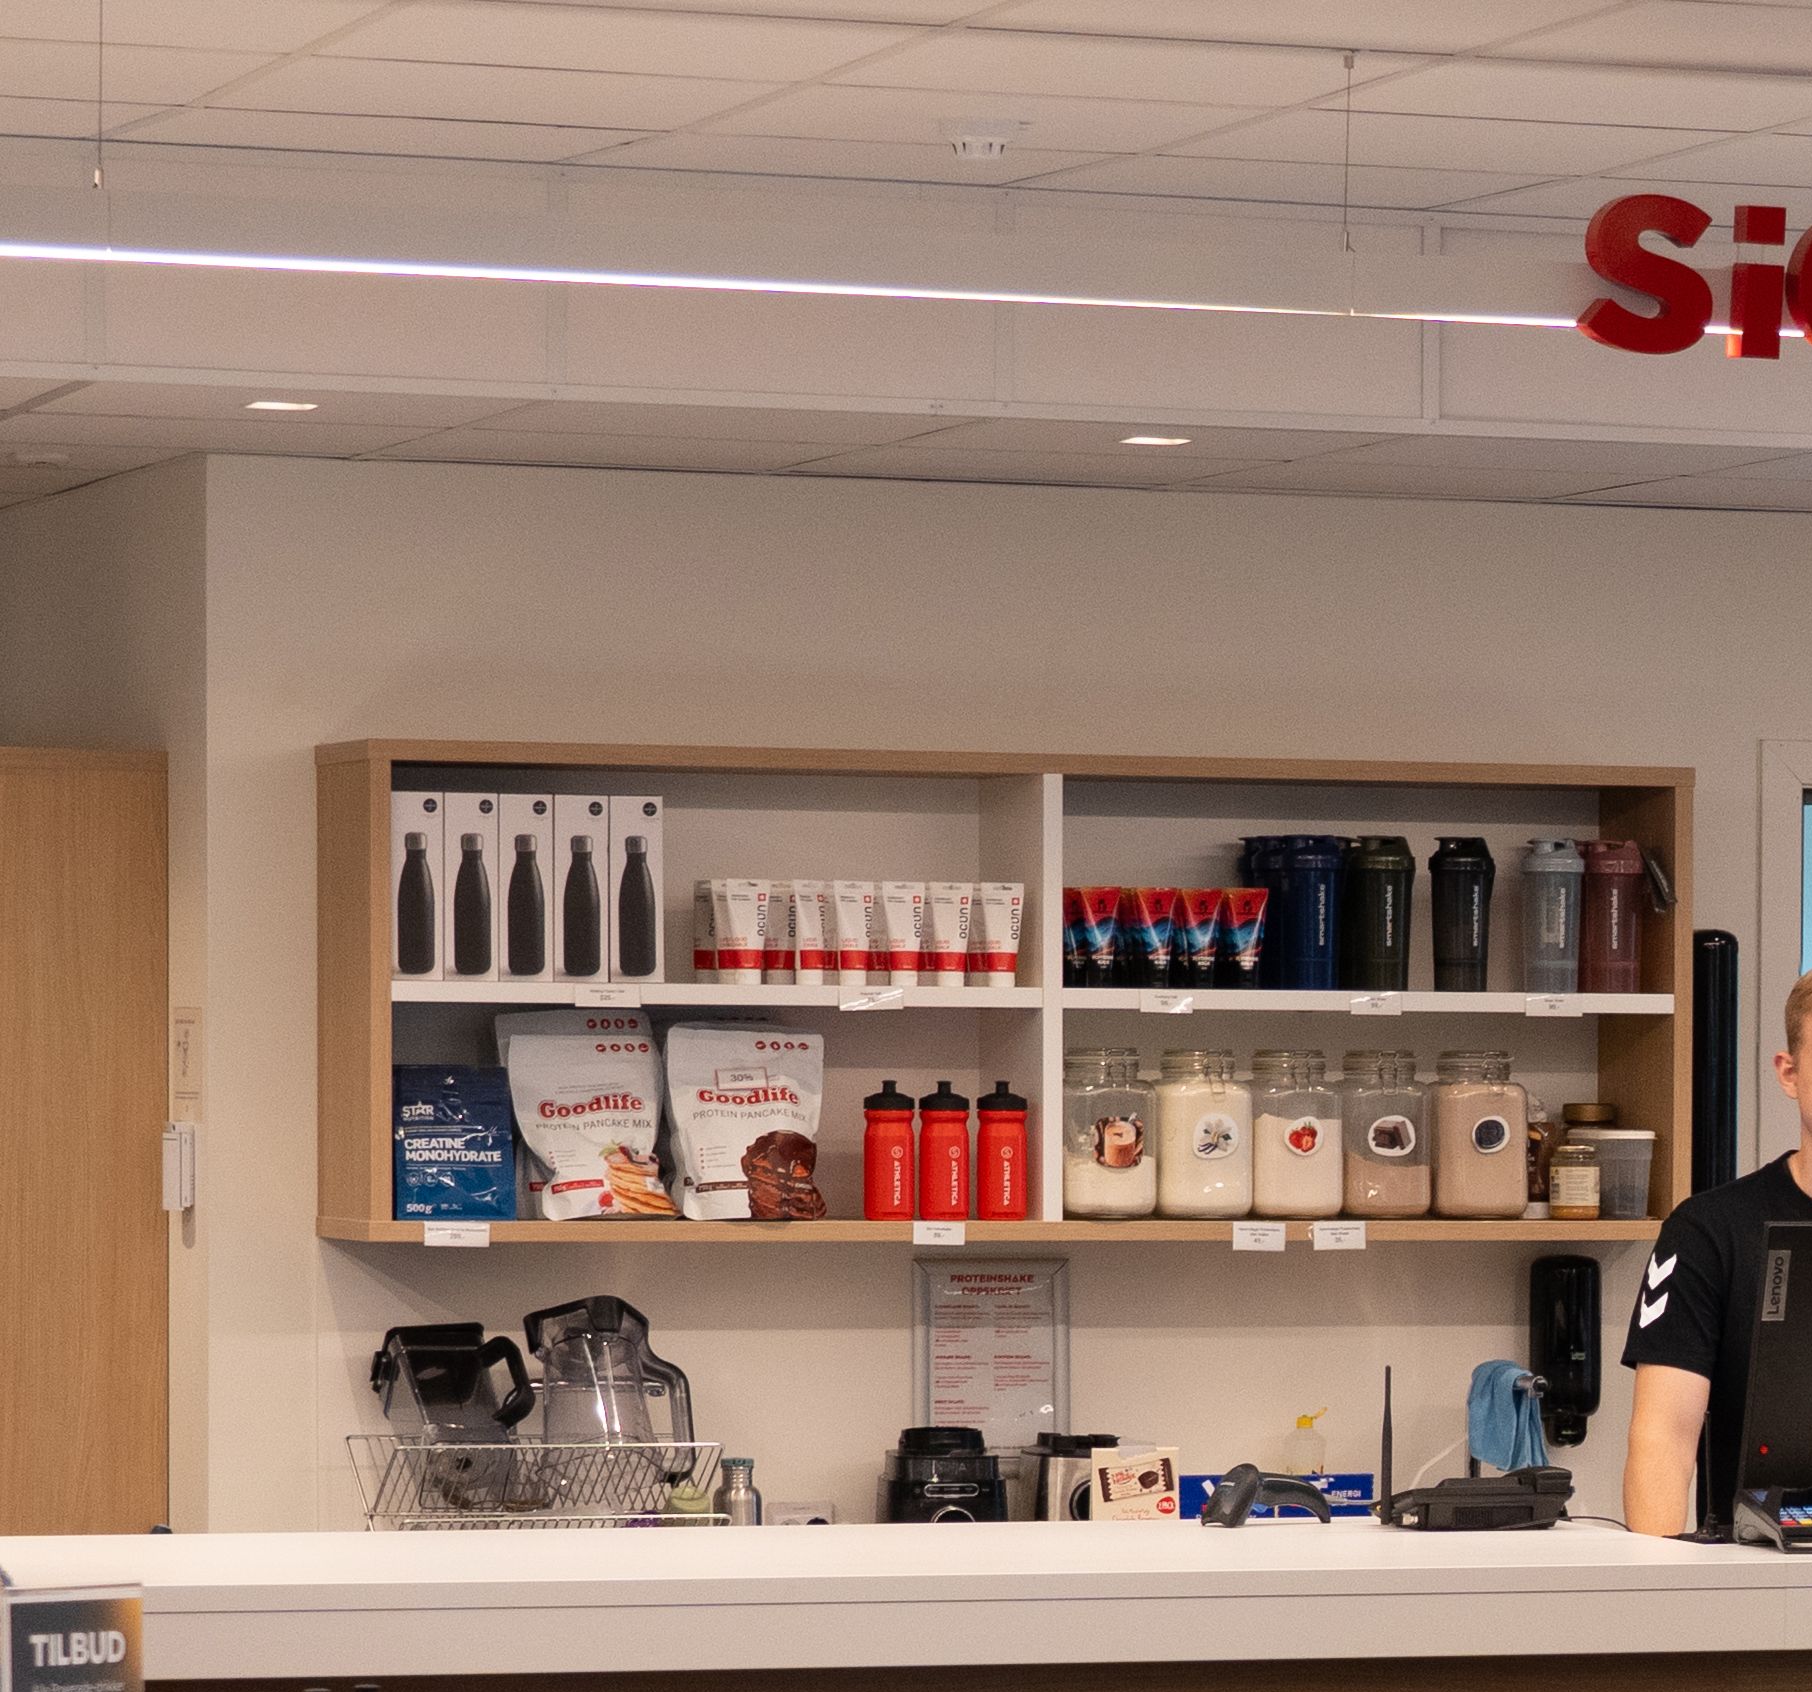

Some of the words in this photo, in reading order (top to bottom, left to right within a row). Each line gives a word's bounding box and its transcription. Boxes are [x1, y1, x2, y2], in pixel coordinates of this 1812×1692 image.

[757, 904, 767, 937] ocun
[958, 906, 969, 939] ocun
[1010, 908, 1020, 940] ocun
[730, 1073, 754, 1082] 30%
[697, 1086, 800, 1105] Goodlife
[402, 1101, 434, 1117] STAR
[539, 1092, 644, 1119] Goodlife
[692, 1108, 738, 1120] PROTEIN
[740, 1108, 790, 1120] PANCAKE
[583, 1119, 630, 1130] PANCAKE
[632, 1119, 652, 1129] MIX
[404, 1138, 466, 1150] CREATINE
[405, 1151, 502, 1162] MONOHYDRATE
[950, 1274, 1035, 1283] PROTEINSHAKE
[1767, 1256, 1784, 1315] Lenovo
[29, 1630, 127, 1668] TILBUD
